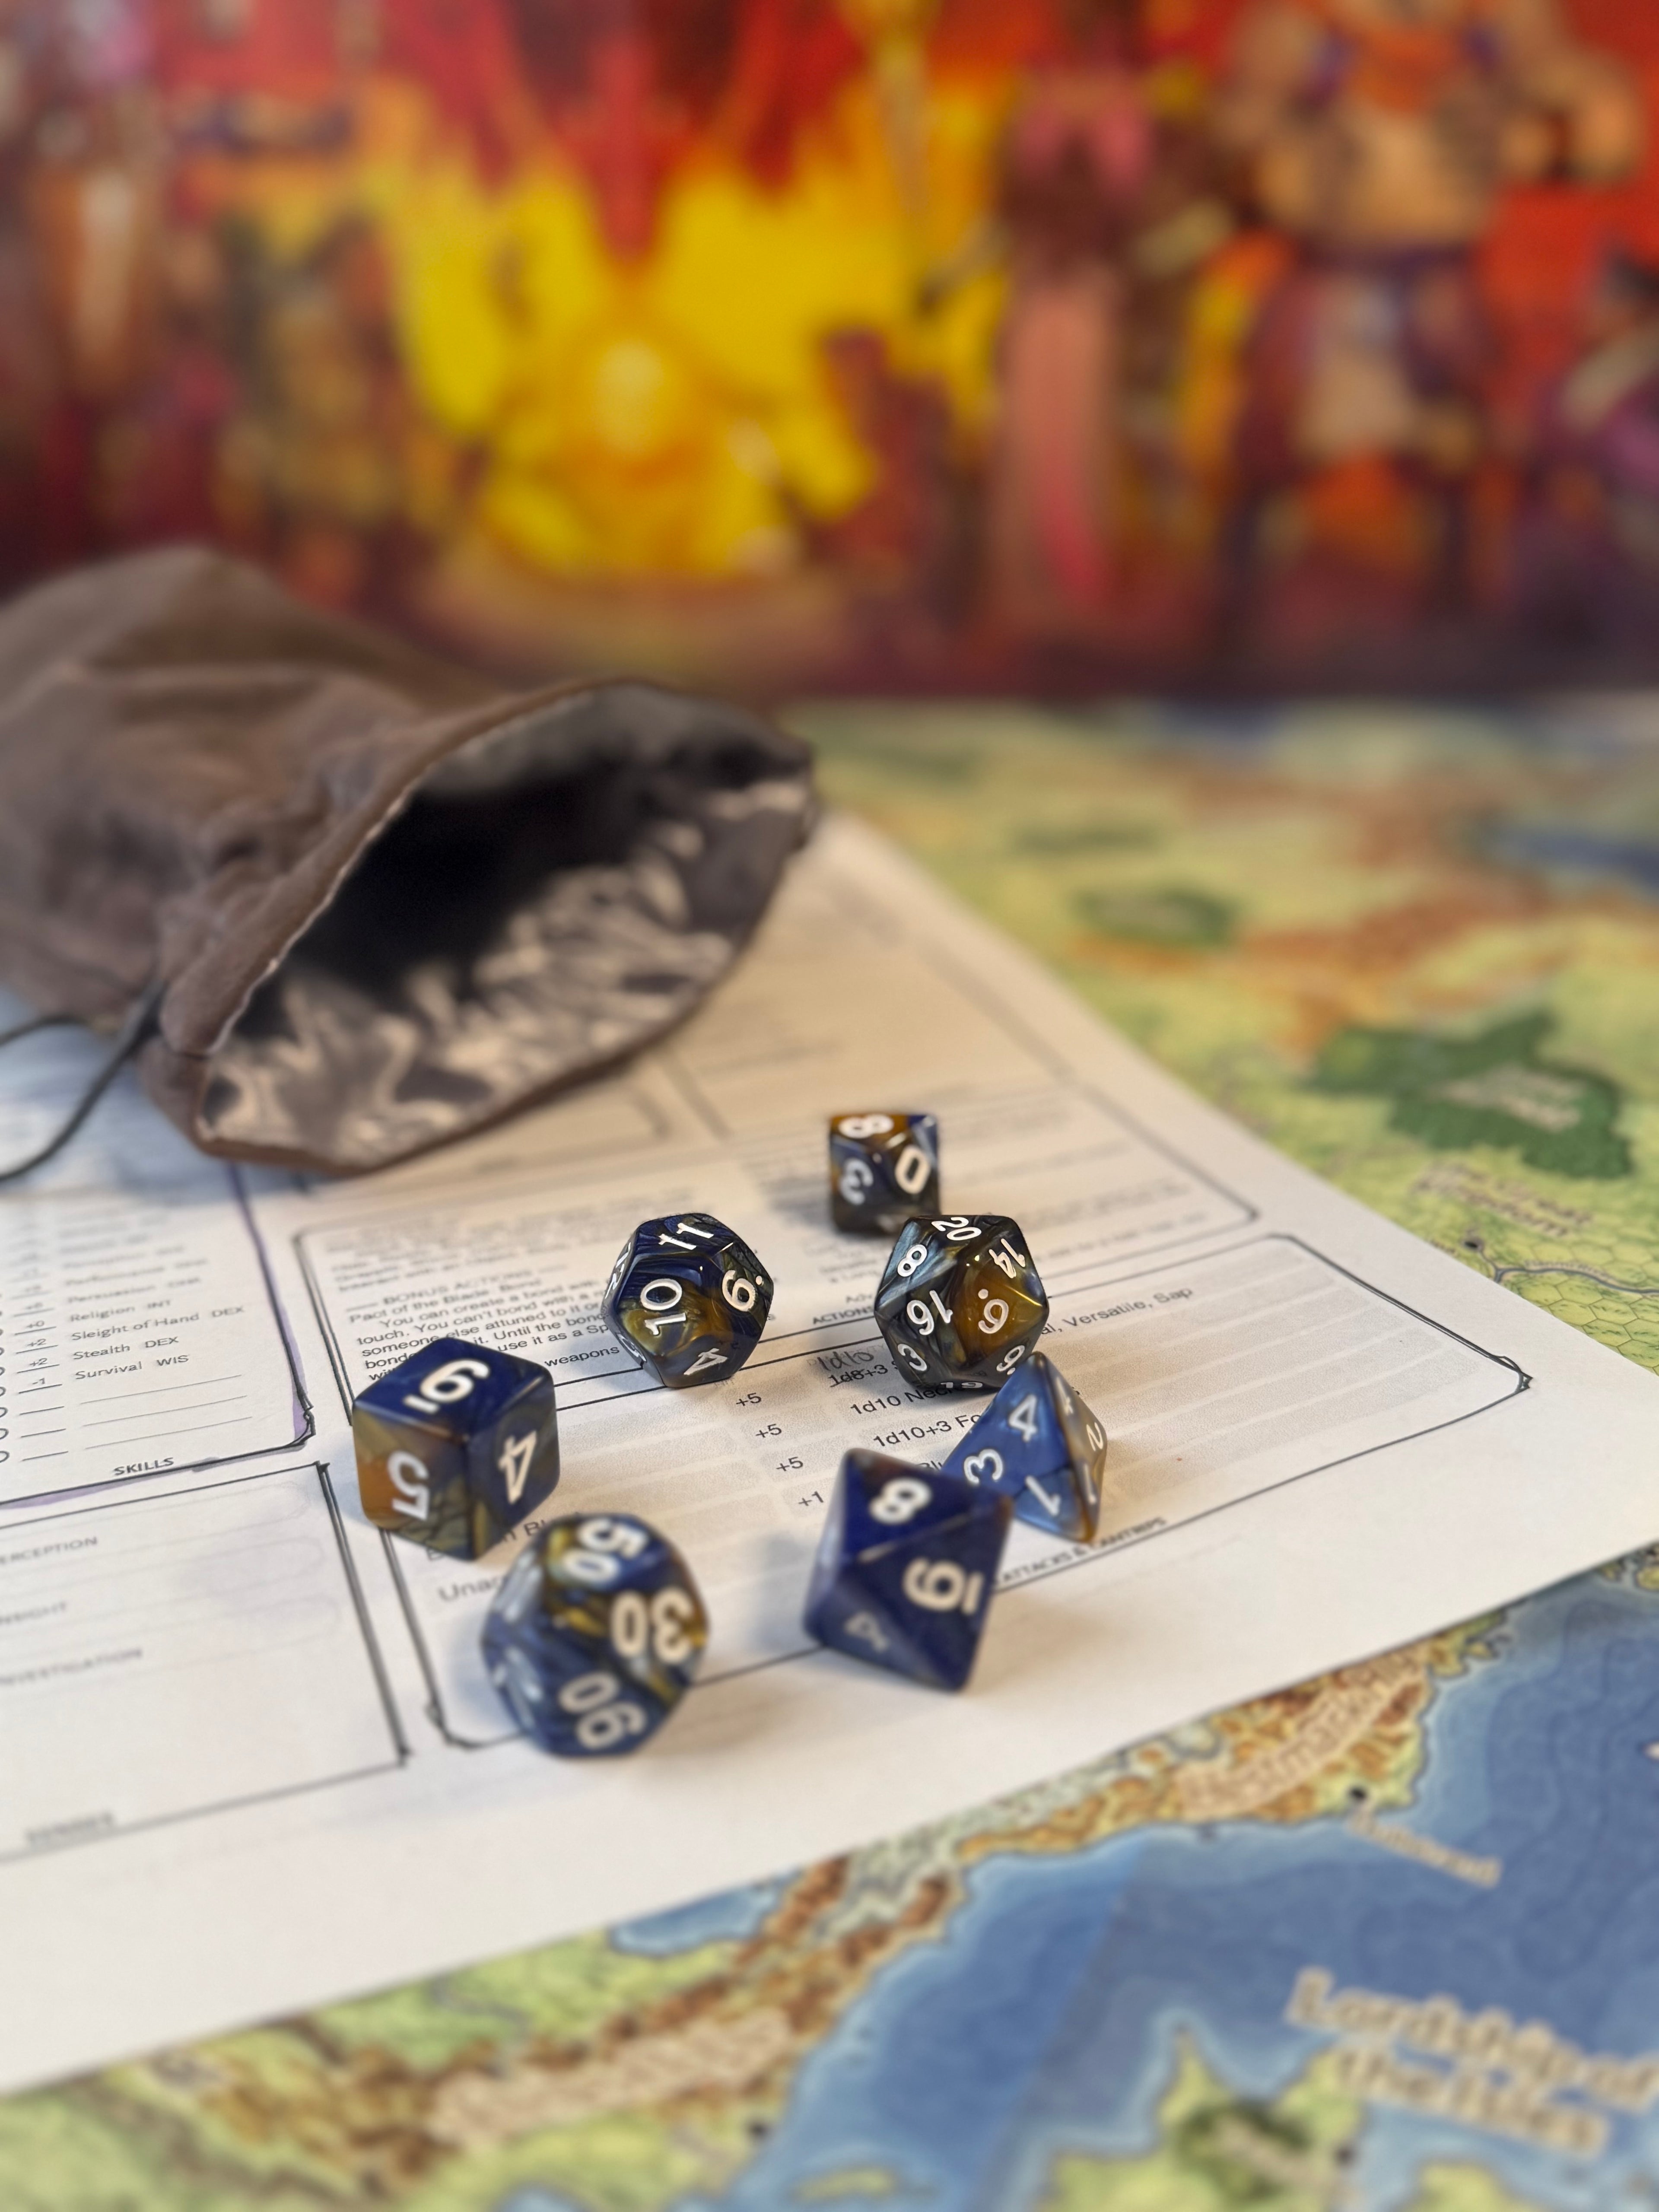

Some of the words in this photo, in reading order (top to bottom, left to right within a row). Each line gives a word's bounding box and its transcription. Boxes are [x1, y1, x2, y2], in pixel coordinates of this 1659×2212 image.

[839, 1114, 894, 1138] 8
[895, 1145, 929, 1194] 0
[658, 1223, 714, 1250] 11
[931, 1217, 981, 1240] 20
[897, 1244, 927, 1277] 8
[989, 1238, 1026, 1278] 14
[70, 1304, 136, 1322] Religion
[349, 1309, 386, 1323] Pact
[392, 1304, 407, 1315] of
[413, 1299, 439, 1311] the
[357, 1330, 410, 1345] touch.
[414, 1321, 448, 1333] You
[454, 1310, 492, 1325] can't
[498, 1302, 537, 1316] bond
[542, 1295, 575, 1306] with
[380, 1316, 413, 1328] You
[419, 1309, 448, 1321] can
[454, 1295, 504, 1313] create
[640, 1278, 686, 1335] 10
[907, 1290, 953, 1335] 16
[1062, 1300, 1153, 1328] Versatile,
[1153, 1288, 1193, 1303] Sap
[27, 1338, 47, 1347] +2
[71, 1324, 129, 1341] Sleight
[133, 1319, 151, 1331] of
[154, 1313, 200, 1327] Hand
[211, 1305, 246, 1318] DEX
[362, 1335, 439, 1357] someone
[445, 1326, 480, 1339] else
[485, 1312, 547, 1331] attuned
[550, 1308, 566, 1316] to
[570, 1304, 580, 1313] it
[474, 1336, 489, 1345] it.
[494, 1326, 531, 1340] Until
[534, 1321, 561, 1332] the
[498, 1340, 528, 1352] use
[534, 1337, 543, 1345] it
[548, 1333, 567, 1342] as
[29, 1358, 48, 1367] +2
[73, 1344, 130, 1360] Stealth
[145, 1336, 180, 1348] DEX
[75, 1361, 143, 1380] Survival
[156, 1355, 190, 1367] WIS
[544, 1346, 620, 1367] weapons
[683, 1348, 728, 1375] 4
[897, 1344, 927, 1371] 3
[736, 1392, 762, 1406] +5
[755, 1424, 782, 1438] +5
[851, 1396, 901, 1414] 1d10
[1008, 1394, 1038, 1443] 4
[776, 1456, 804, 1471] +5
[873, 1421, 952, 1446] 1d10+3
[113, 1457, 174, 1475] SKILLS
[499, 1431, 537, 1504] 4
[964, 1449, 1003, 1485] 3
[388, 1450, 429, 1521] 5
[798, 1491, 824, 1506] +1
[869, 1478, 932, 1525] 8
[1025, 1475, 1061, 1516] 1
[562, 1518, 648, 1584] 50
[611, 1587, 693, 1665] 30
[843, 1610, 889, 1654] 4
